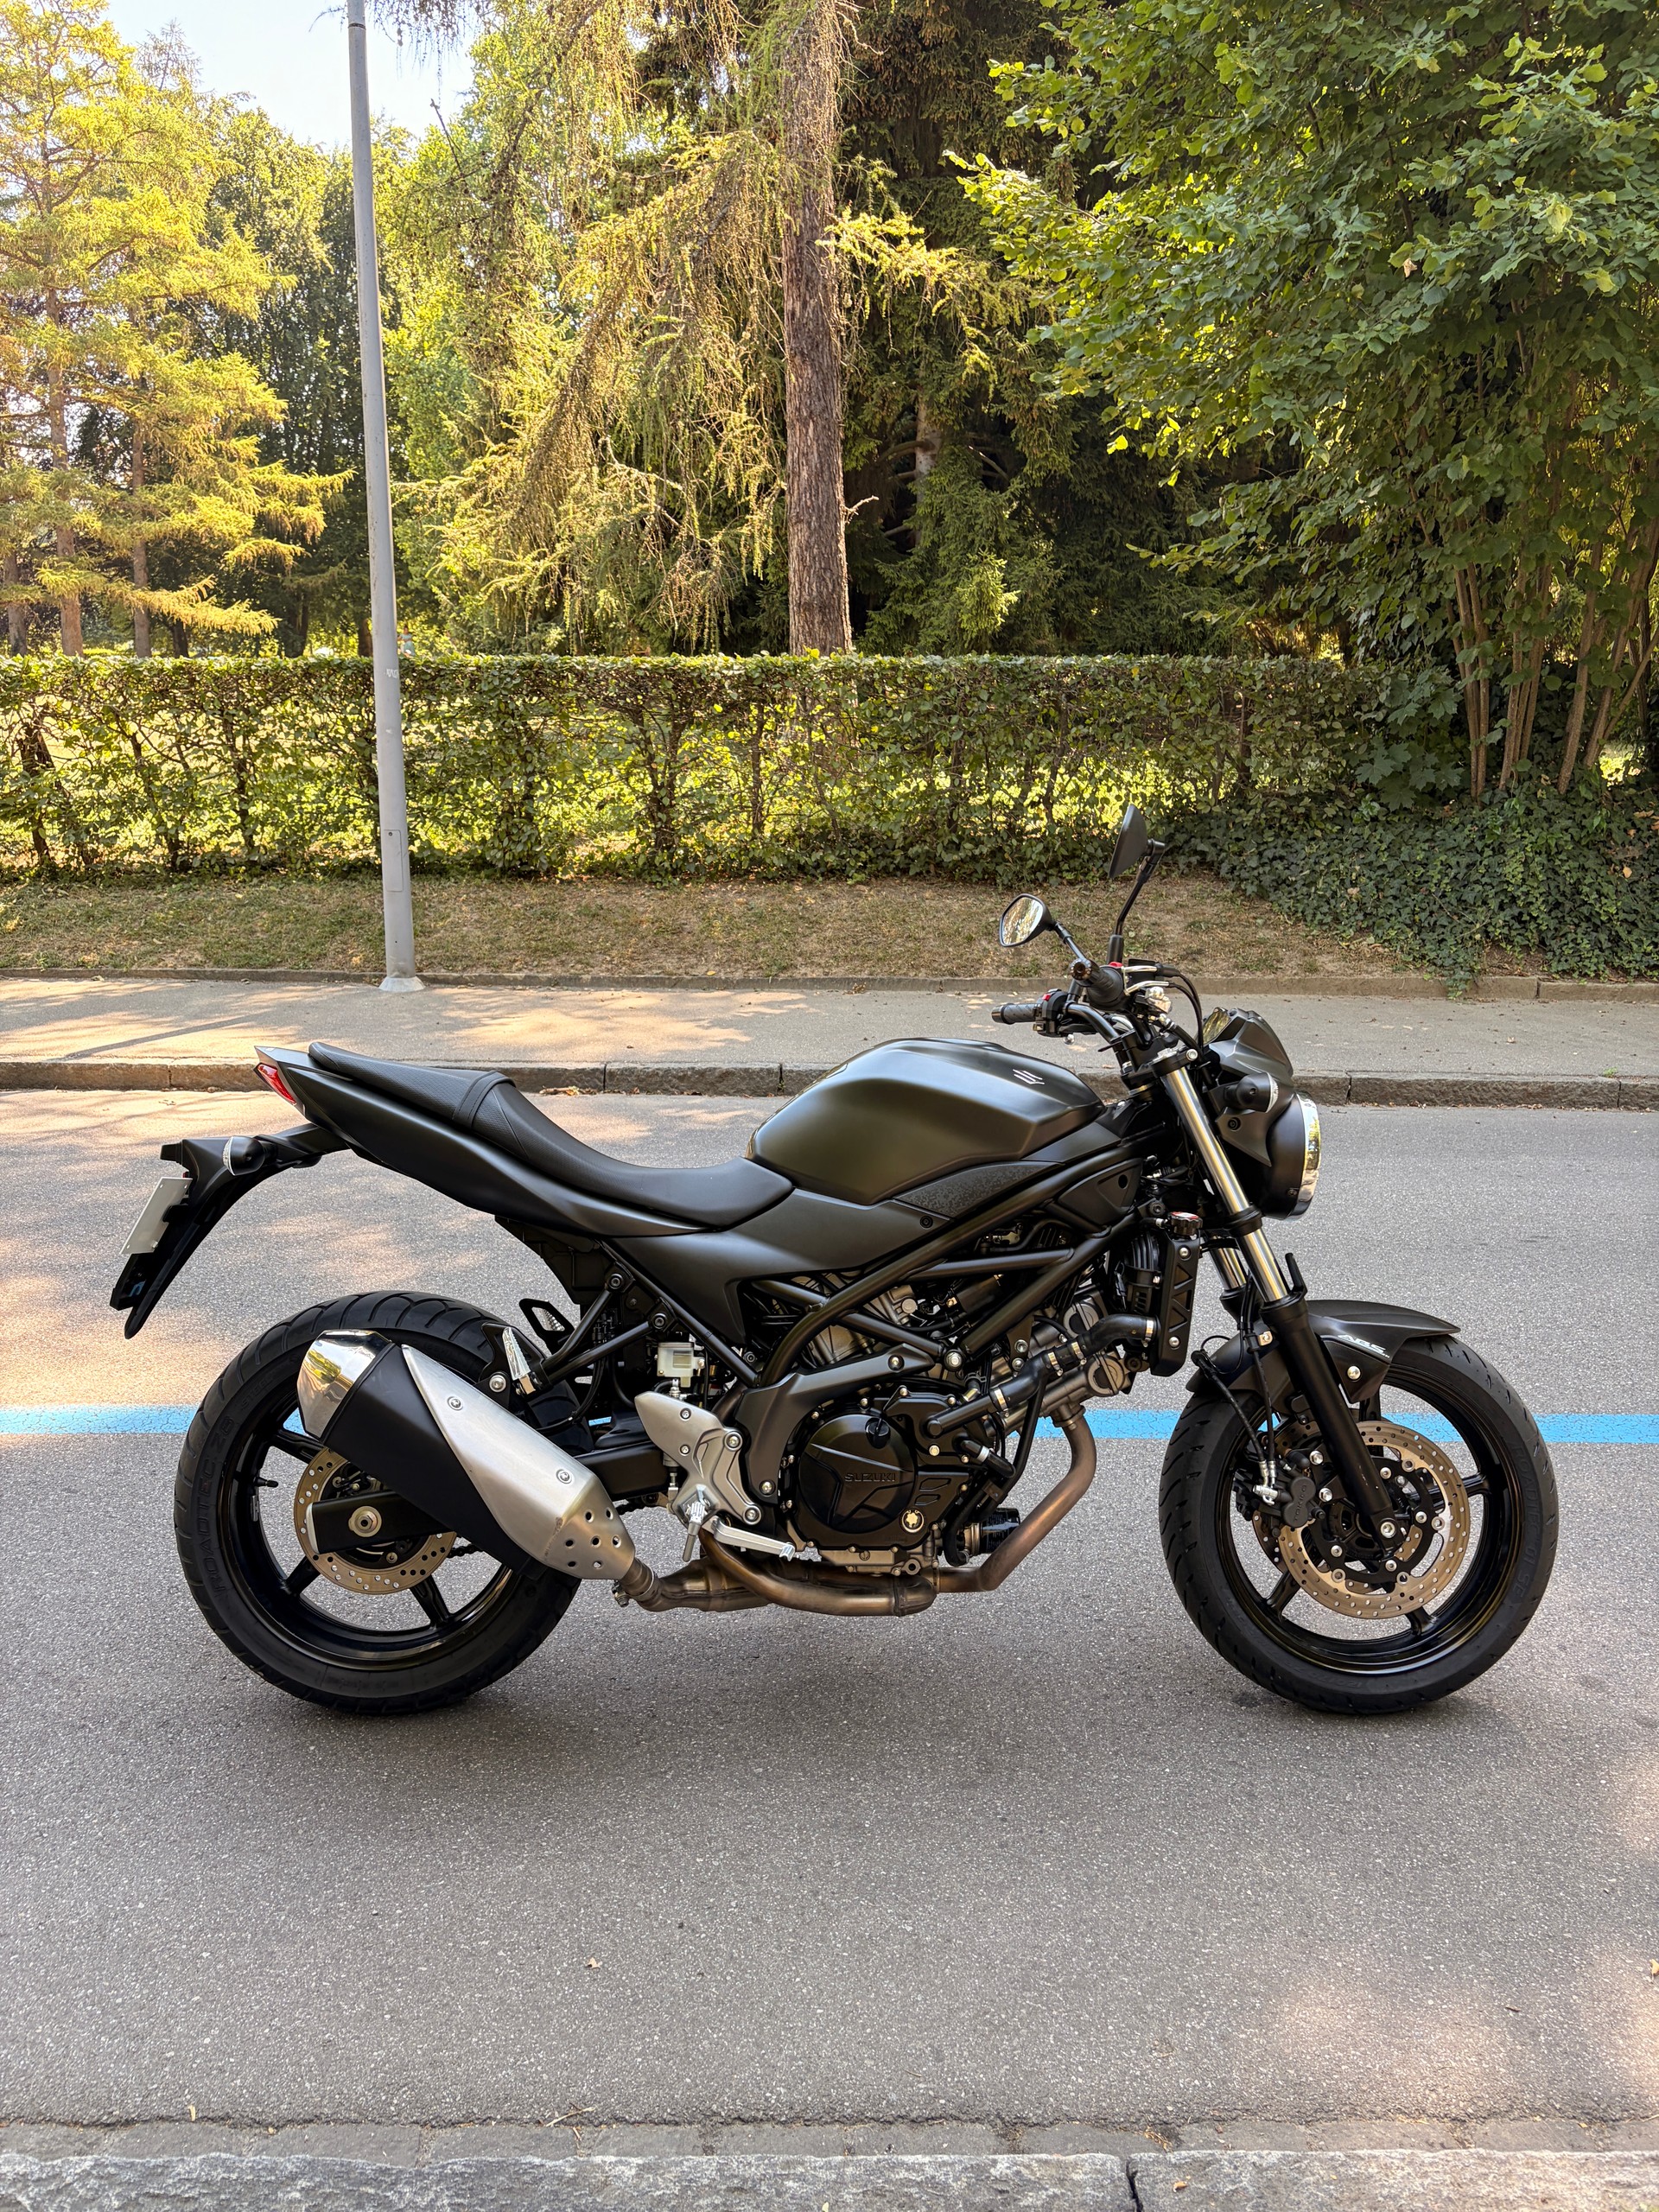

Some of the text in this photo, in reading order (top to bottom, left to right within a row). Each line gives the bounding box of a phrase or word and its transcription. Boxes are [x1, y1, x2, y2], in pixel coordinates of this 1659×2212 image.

[1338, 1335, 1386, 1353] ABS
[844, 1472, 896, 1483] SUZUKI
[196, 1457, 227, 1593] ROADTEC
